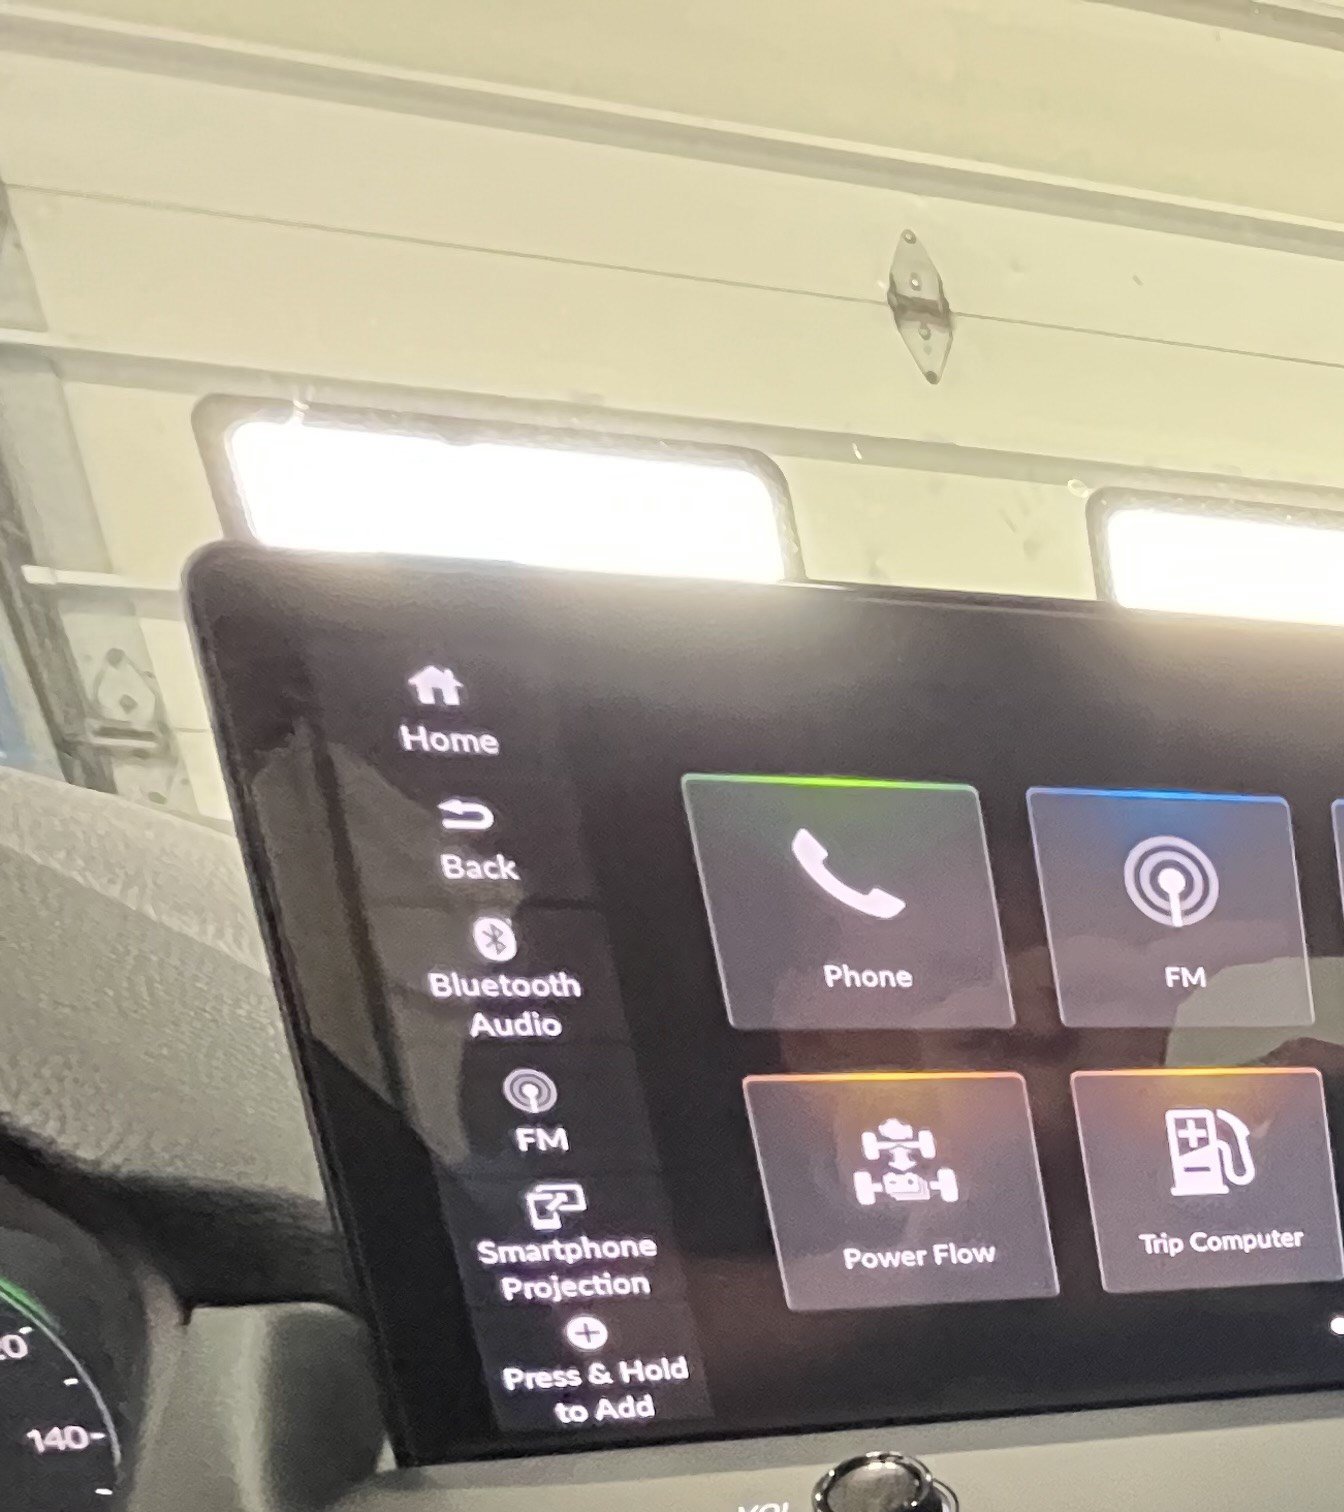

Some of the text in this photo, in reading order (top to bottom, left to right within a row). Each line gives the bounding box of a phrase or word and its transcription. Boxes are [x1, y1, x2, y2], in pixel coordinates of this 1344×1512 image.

[399, 724, 500, 755] Home
[439, 853, 520, 881] Back
[427, 971, 582, 998] Bluetooth
[823, 963, 913, 988] Phone
[1164, 966, 1207, 988] FM
[469, 1010, 563, 1038] Audio
[515, 1127, 570, 1152] FM
[476, 1234, 658, 1266] Smartphone
[842, 1242, 996, 1270] Power Flow
[1138, 1229, 1305, 1258] Trip Computer
[500, 1271, 651, 1303] Projection
[502, 1355, 689, 1391] Press & Hold
[554, 1393, 656, 1424] to Add
[26, 1425, 90, 1454] 140
